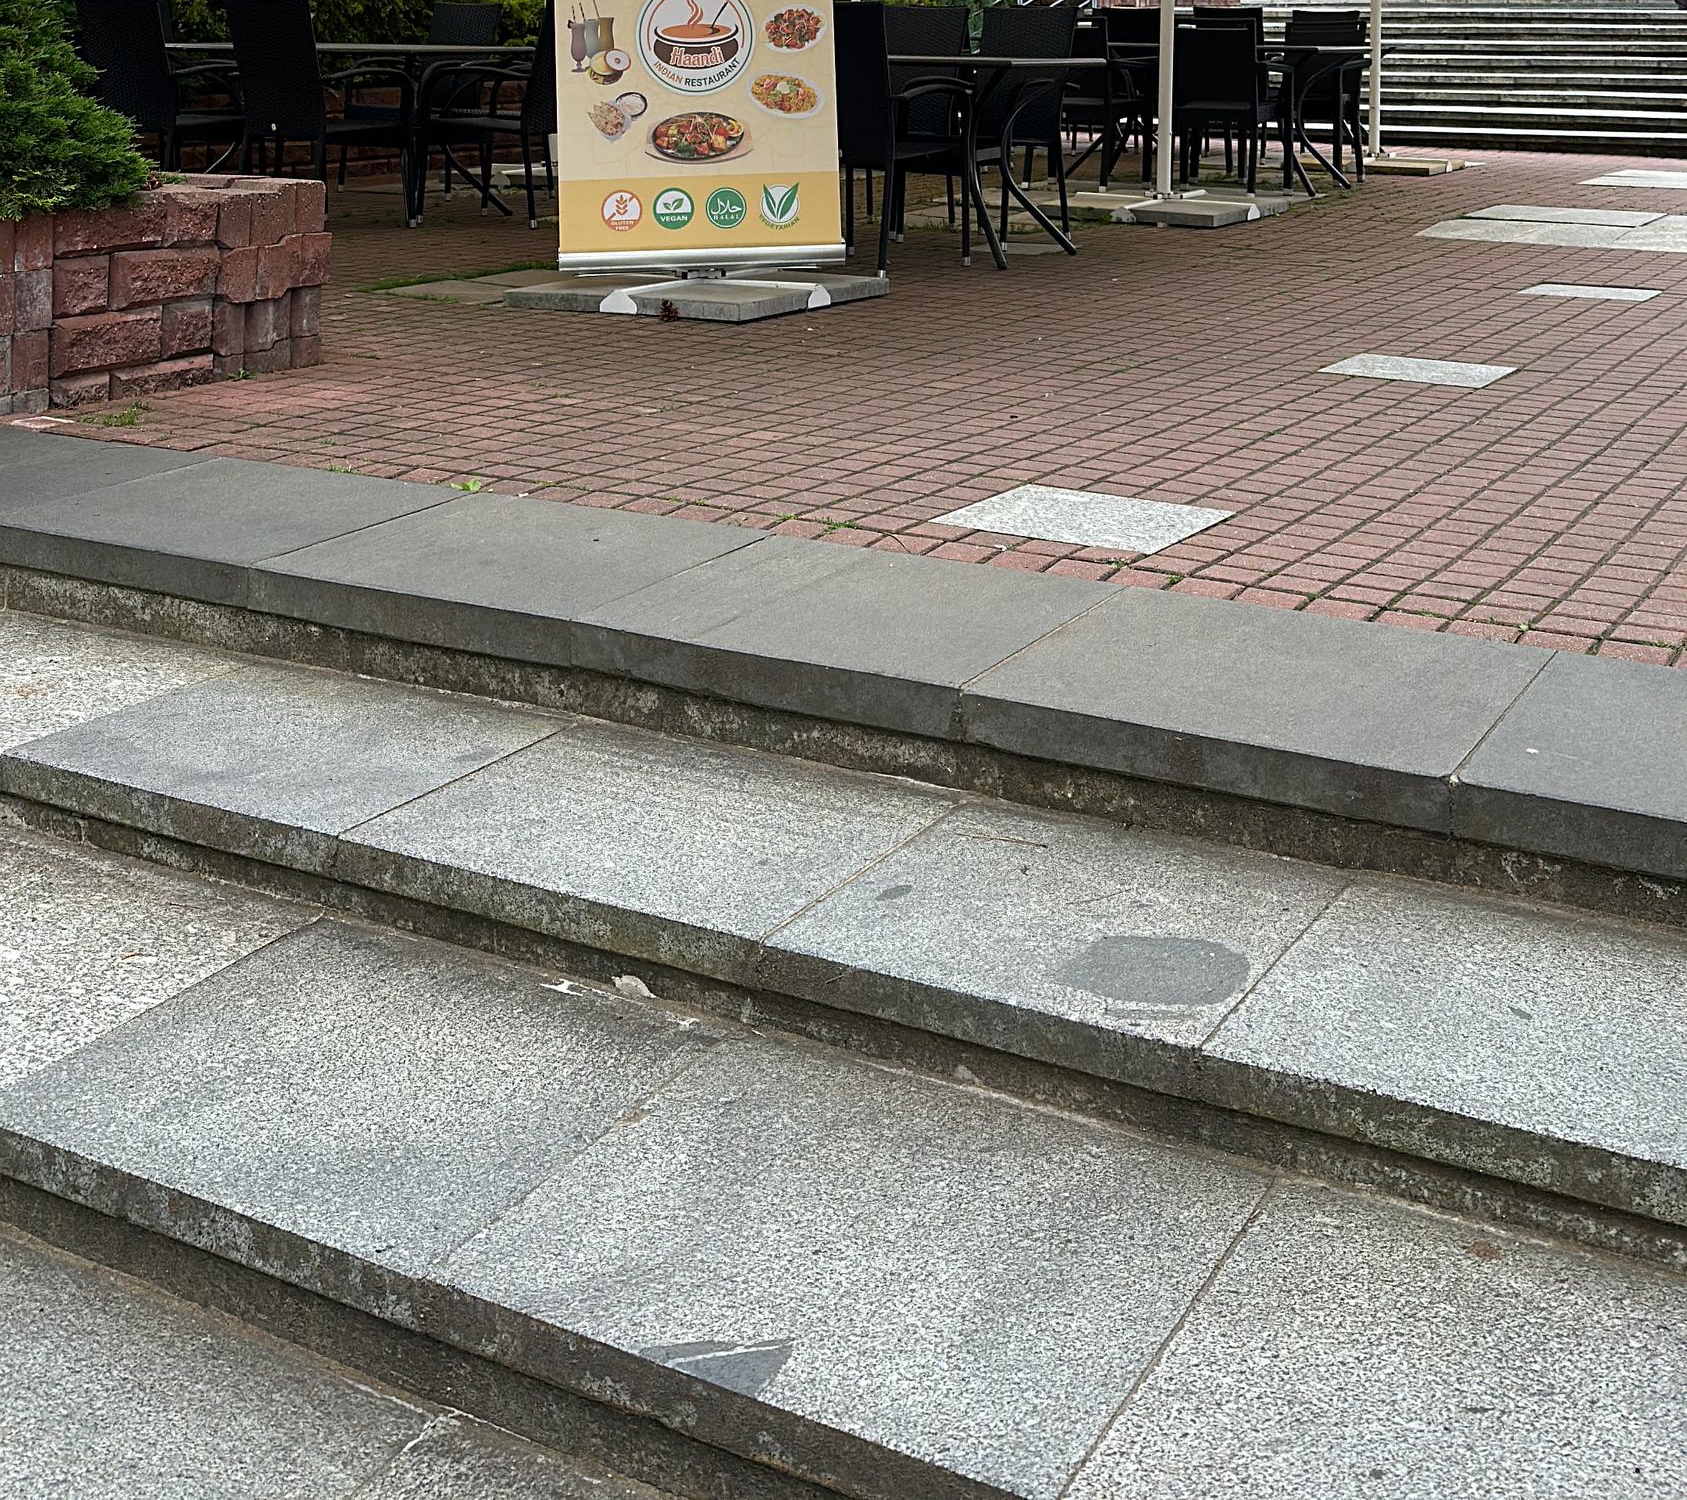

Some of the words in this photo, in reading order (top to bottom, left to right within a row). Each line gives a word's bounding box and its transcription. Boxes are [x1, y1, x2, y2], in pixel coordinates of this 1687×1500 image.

[669, 46, 725, 67] Haandi
[654, 61, 683, 84] INDIAN
[684, 57, 740, 86] RESTAURANT
